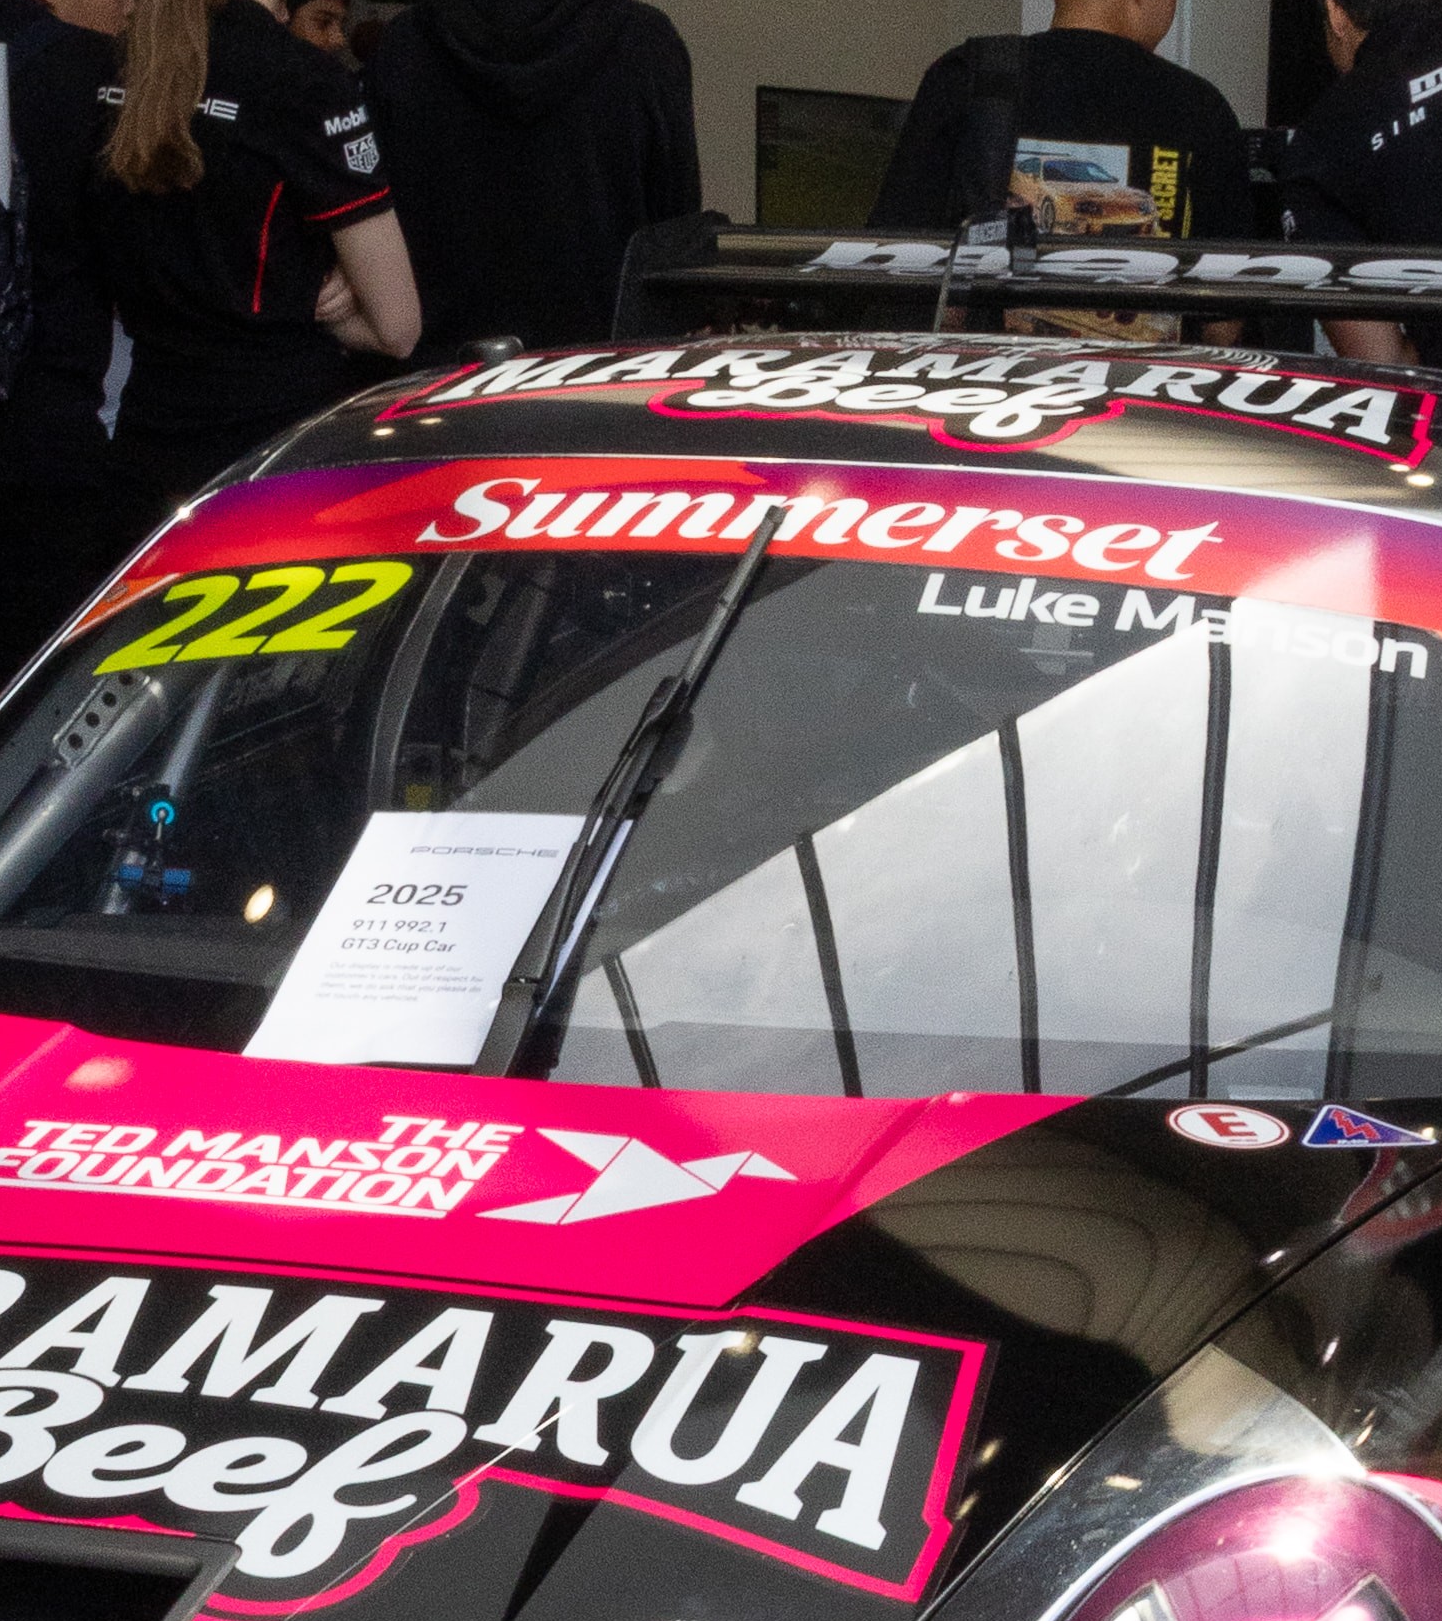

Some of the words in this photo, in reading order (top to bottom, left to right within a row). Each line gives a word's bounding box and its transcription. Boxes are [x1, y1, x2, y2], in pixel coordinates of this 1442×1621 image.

[1371, 106, 1426, 151] SIM
[427, 348, 1393, 446] MARAMARUA
[687, 374, 1106, 439] Beef
[416, 476, 1223, 583] Summerset
[92, 561, 415, 676] 222
[918, 573, 1095, 630] Luke
[1113, 591, 1431, 680] Manson
[409, 845, 560, 858] PORSCHE
[366, 883, 469, 907] 2025
[340, 937, 379, 951] GT3
[383, 938, 420, 954] Cup
[423, 939, 457, 953] Car
[352, 919, 388, 932] 911
[394, 920, 448, 934] 992.1
[380, 1116, 525, 1154] THE
[1199, 1111, 1258, 1137] E
[11, 1121, 157, 1155] TED
[161, 1130, 501, 1180] MANSON
